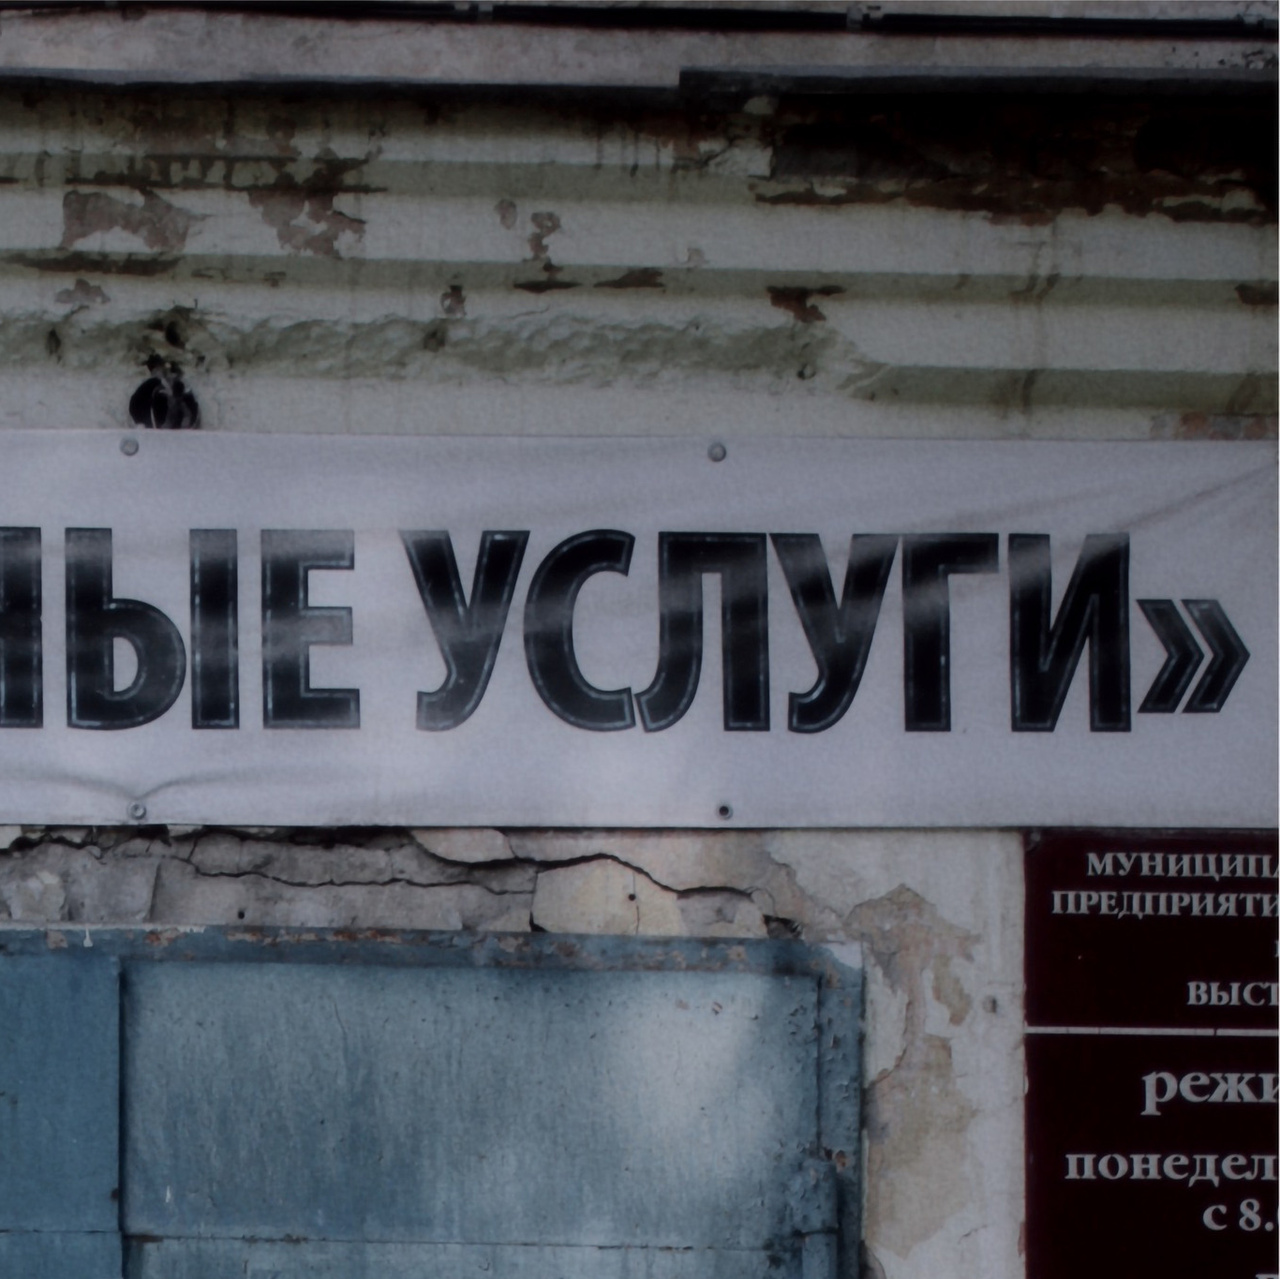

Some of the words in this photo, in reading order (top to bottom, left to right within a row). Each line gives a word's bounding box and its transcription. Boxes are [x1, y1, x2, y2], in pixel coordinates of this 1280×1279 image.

[400, 529, 1251, 733] УСЛУГИ»
[1087, 851, 1278, 881] МУНИЦИП
[1203, 1205, 1227, 1231] с
[1239, 1198, 1278, 1232] 8.
